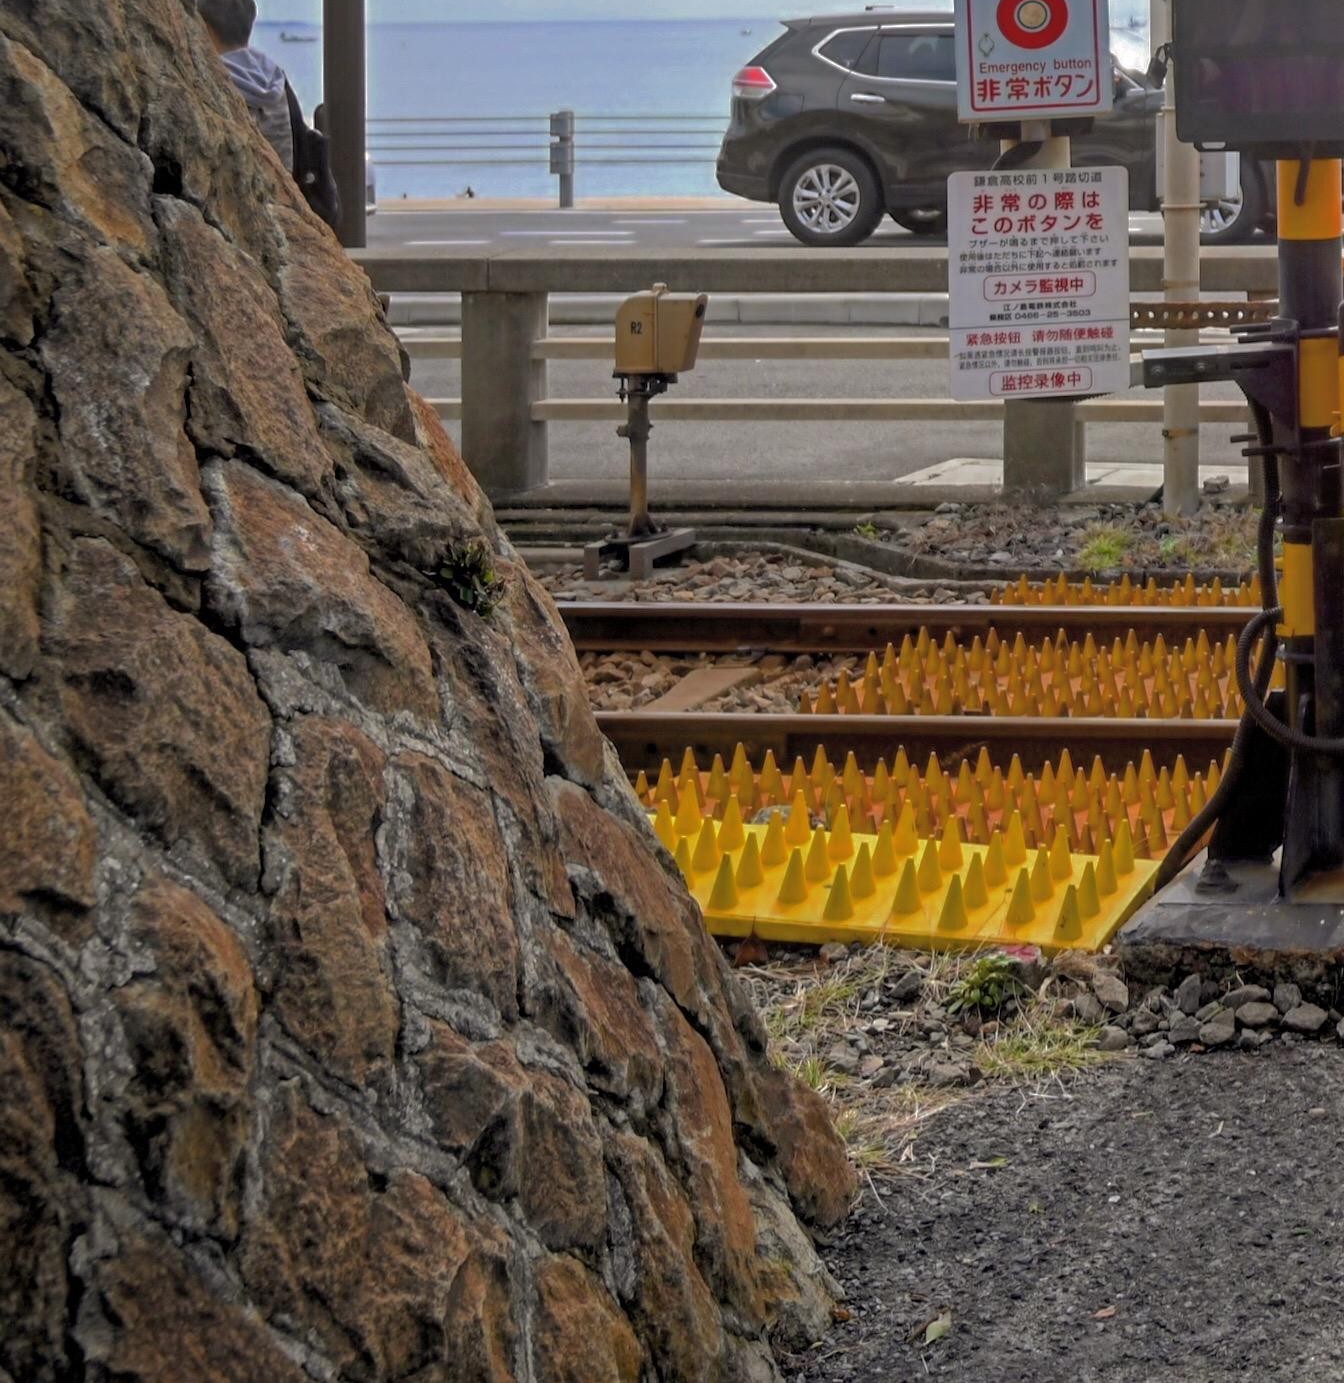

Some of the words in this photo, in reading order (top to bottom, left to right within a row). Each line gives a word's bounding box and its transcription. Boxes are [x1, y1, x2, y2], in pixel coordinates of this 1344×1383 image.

[979, 62, 1046, 74] Emergency
[1053, 59, 1091, 70] button
[977, 74, 1093, 102] 非常ボタン
[973, 191, 1100, 213] 非常の際は
[972, 214, 1103, 235] このボタンを
[993, 277, 1084, 295] カメラ監視中
[631, 321, 643, 335] R2
[966, 331, 1021, 346] 紧急按钮
[1032, 327, 1114, 343] 请勿随便触碰
[1001, 371, 1081, 391] 监控录像中
